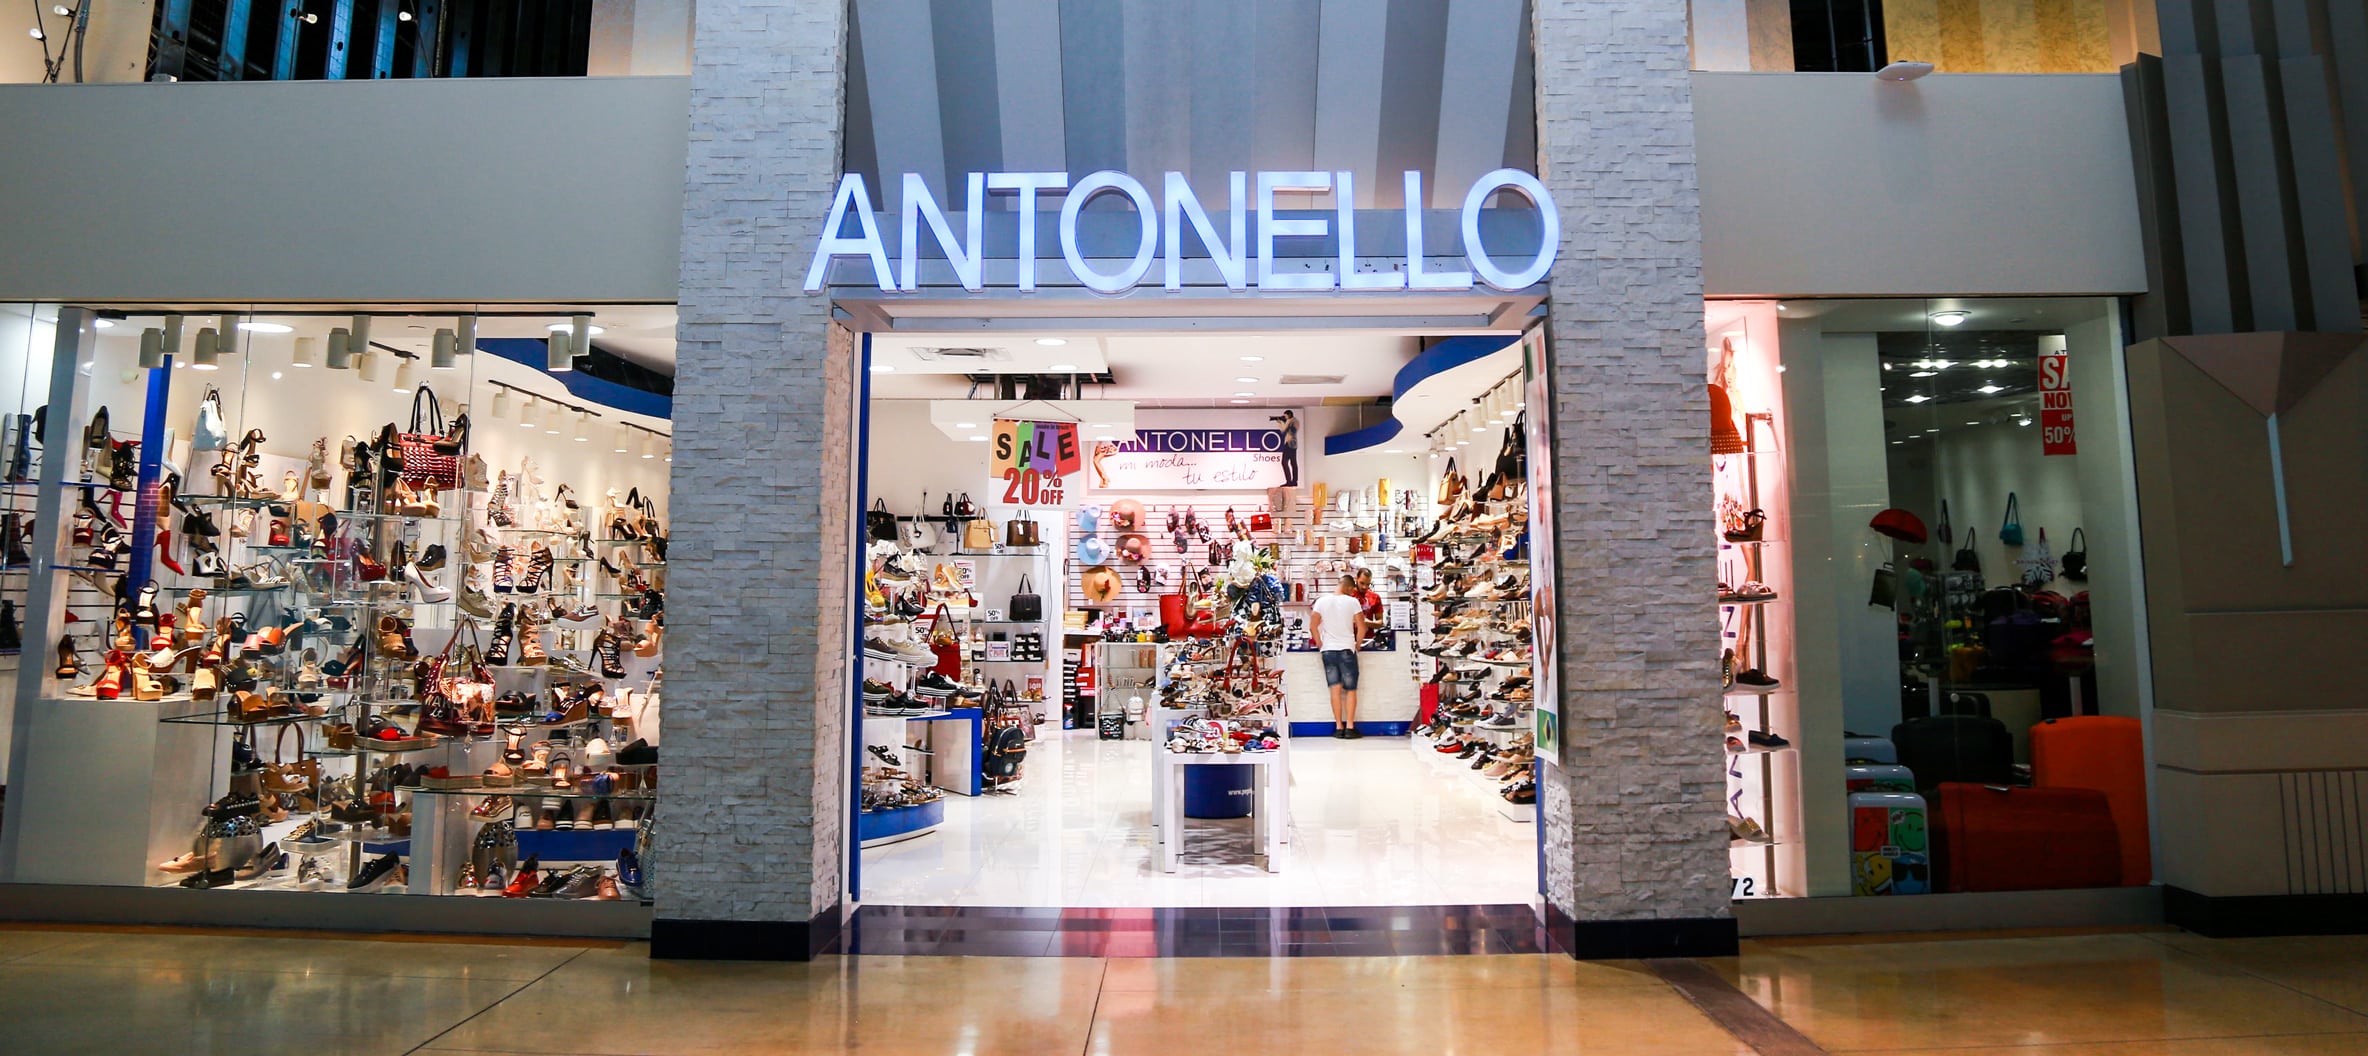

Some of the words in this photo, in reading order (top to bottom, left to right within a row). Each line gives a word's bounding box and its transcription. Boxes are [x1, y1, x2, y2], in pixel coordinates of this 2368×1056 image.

[804, 168, 1560, 294] ANTONELLO
[2044, 392, 2072, 408] NO
[996, 431, 1075, 467] SALE
[1253, 453, 1280, 463] Shoes
[1003, 467, 1063, 505] 20%
[1040, 489, 1064, 505] OFF
[1182, 469, 1203, 485] tu
[1213, 466, 1259, 483] estilo
